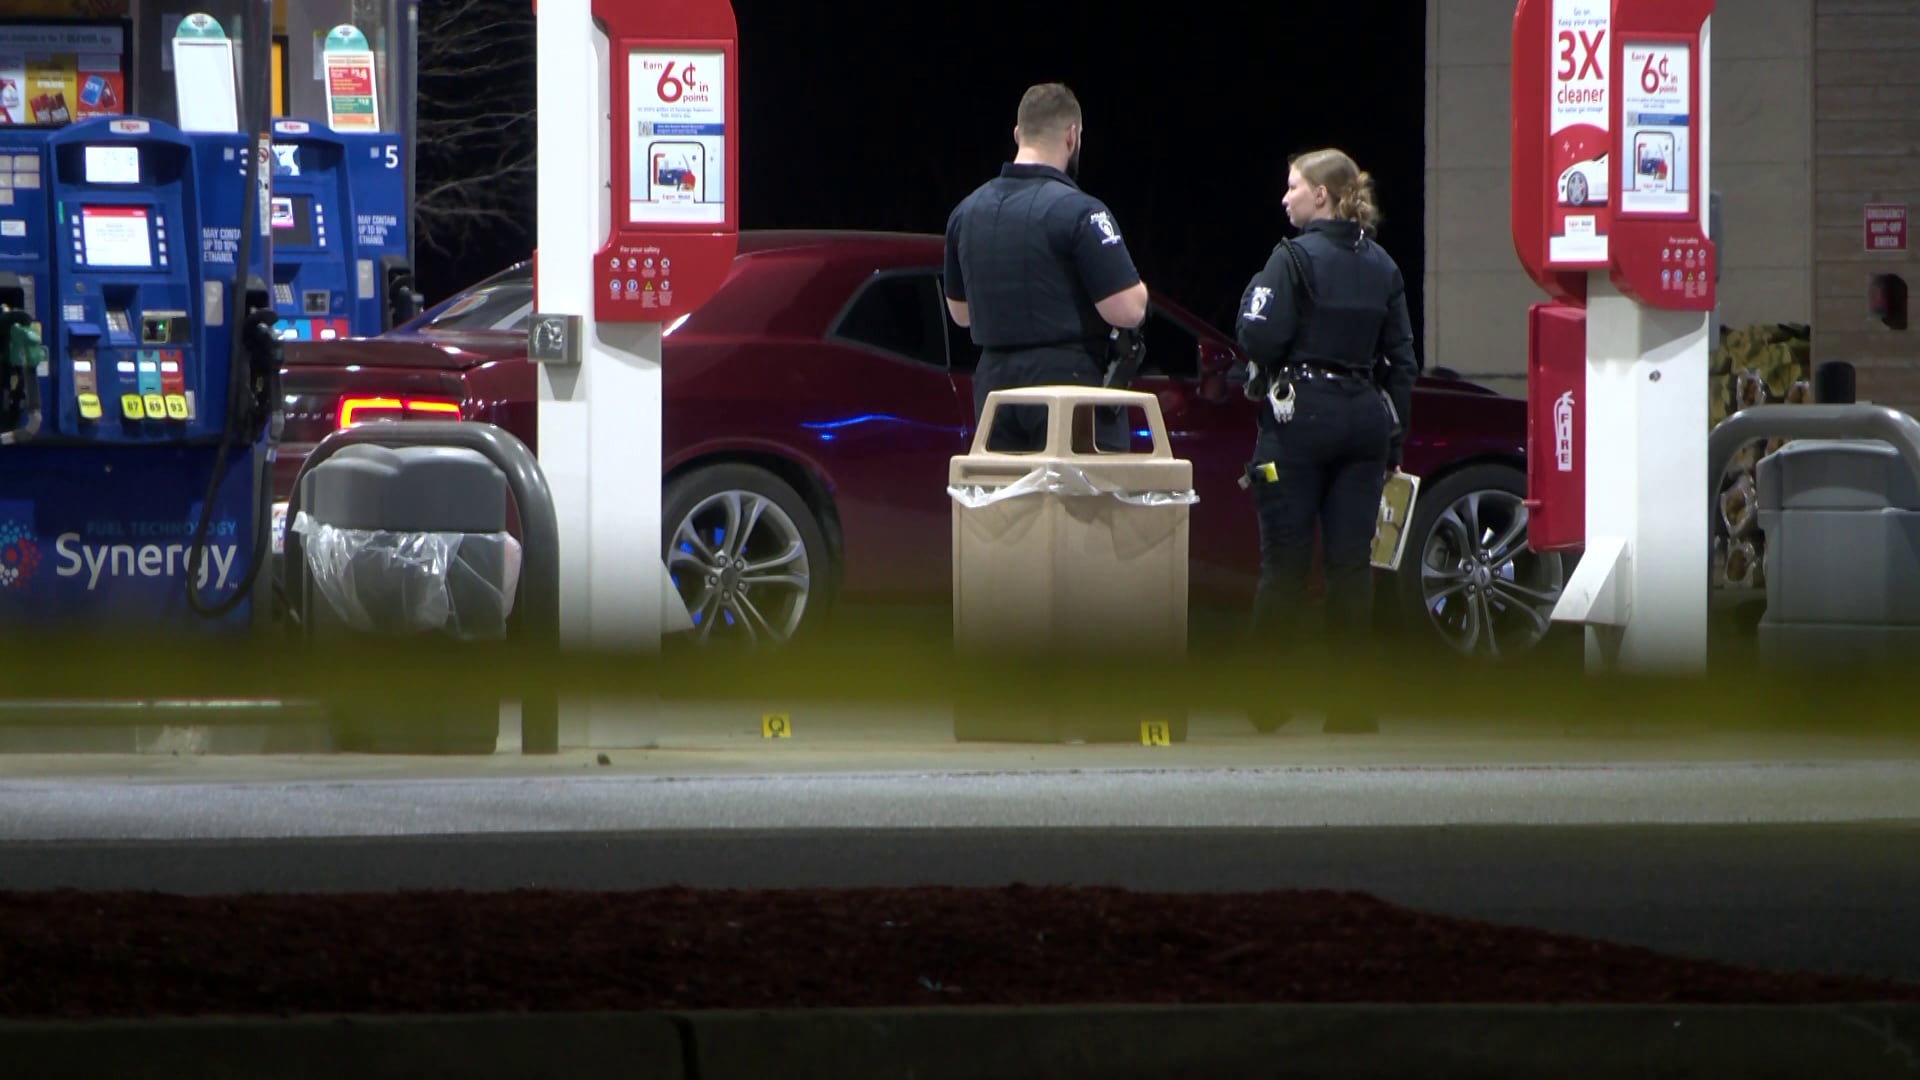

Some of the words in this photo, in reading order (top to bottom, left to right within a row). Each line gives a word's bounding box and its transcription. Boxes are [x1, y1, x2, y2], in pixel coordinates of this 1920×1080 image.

[1557, 29, 1606, 82] 3X
[1631, 52, 1645, 61] Earn
[1641, 52, 1668, 94] 6¢
[1670, 72, 1678, 83] in
[643, 61, 663, 70] Earn
[657, 61, 696, 103] 6¢
[699, 82, 709, 92] in
[1557, 83, 1605, 104] cleaner
[1659, 86, 1678, 95] points
[682, 94, 709, 103] points
[384, 144, 399, 169] 5
[358, 215, 371, 225] MAY
[372, 215, 397, 226] CONTAIN
[203, 228, 218, 239] MAY
[219, 228, 242, 240] CONTA
[358, 225, 367, 235] UP
[367, 225, 376, 235] TO
[203, 239, 213, 250] UP
[213, 239, 223, 250] TO
[223, 240, 238, 252] 10%
[359, 235, 384, 246] ETHANOL
[620, 245, 630, 253] For
[643, 245, 660, 254] safety
[203, 251, 234, 263] ETHANOL
[127, 401, 139, 411] 87
[171, 402, 183, 412] 93
[1560, 413, 1569, 464] FIRE
[86, 521, 123, 536] FUEL
[129, 520, 237, 536] TECHNOOGY
